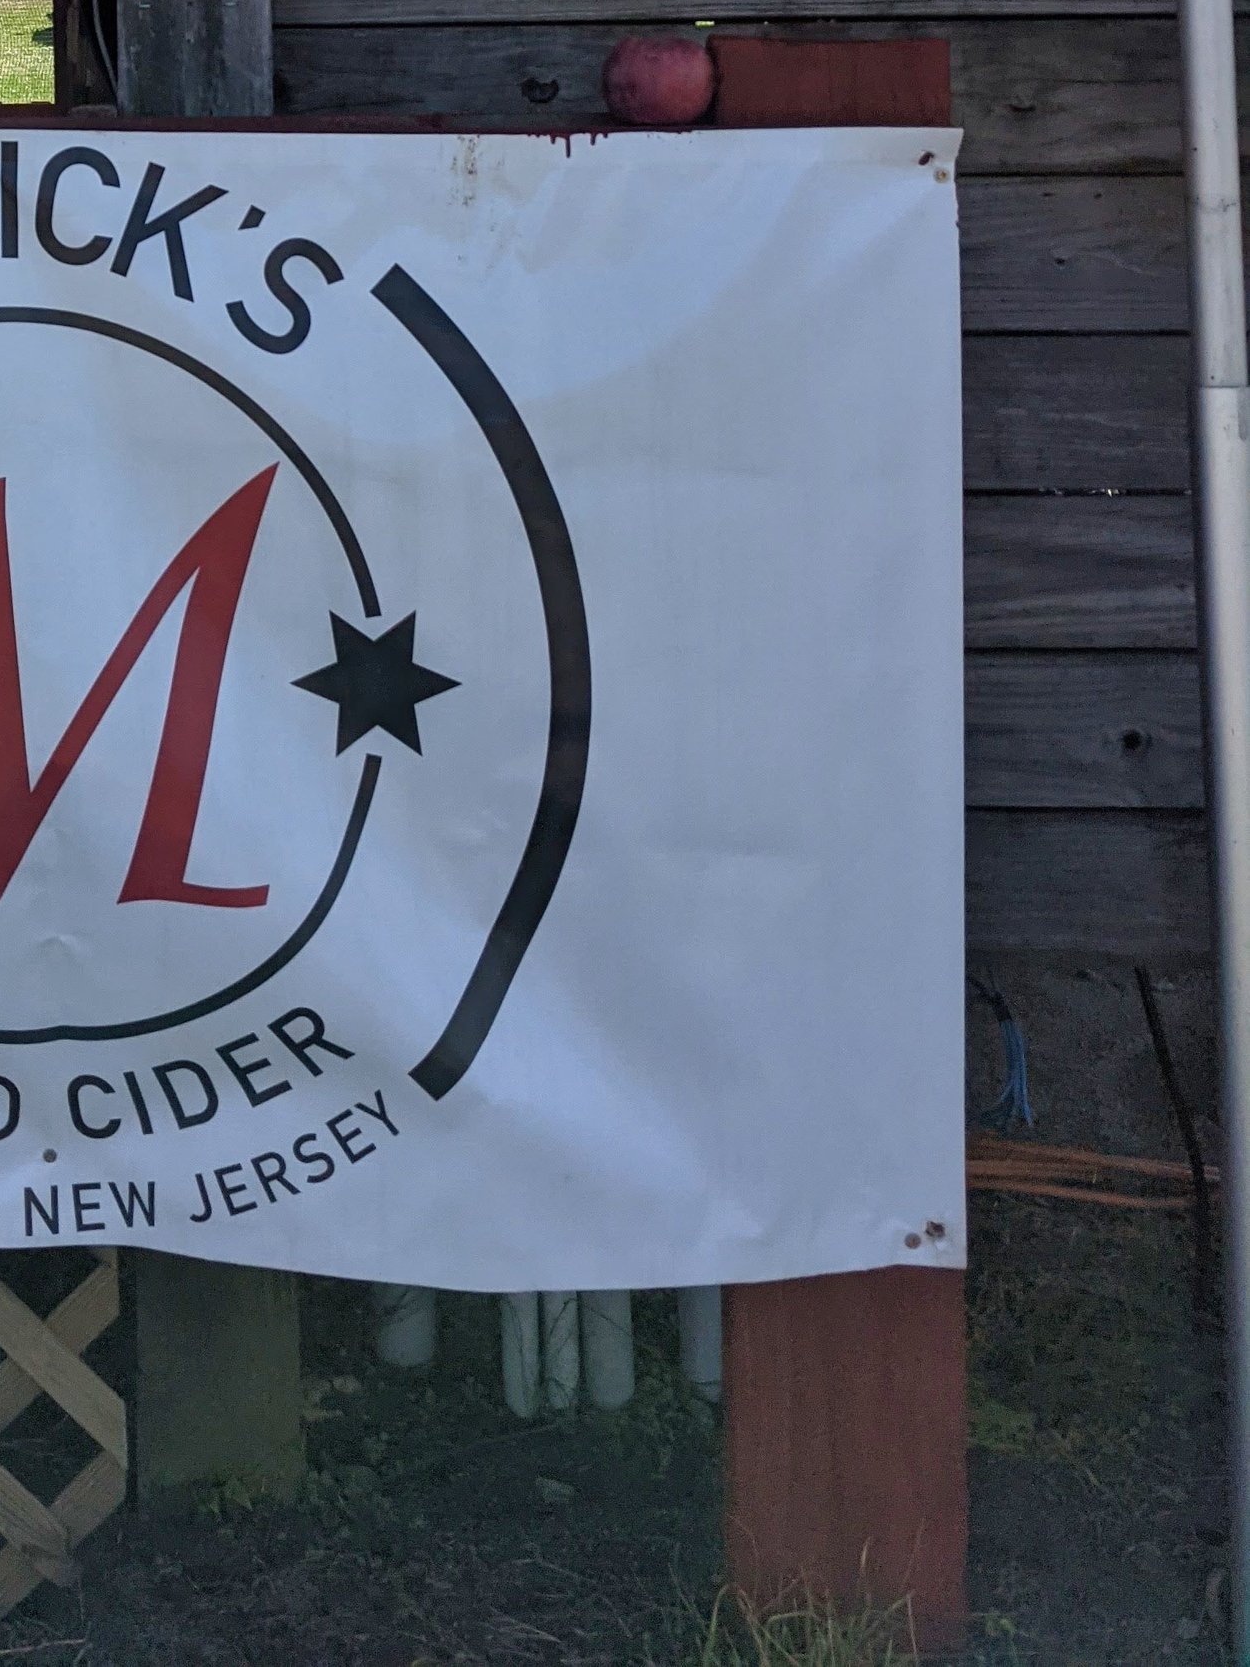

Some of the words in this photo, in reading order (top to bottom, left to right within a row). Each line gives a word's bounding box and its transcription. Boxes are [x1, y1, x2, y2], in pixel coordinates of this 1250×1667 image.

[67, 1006, 356, 1139] CIDER
[24, 1180, 156, 1237] NEW
[189, 1090, 400, 1224] JERSEY
